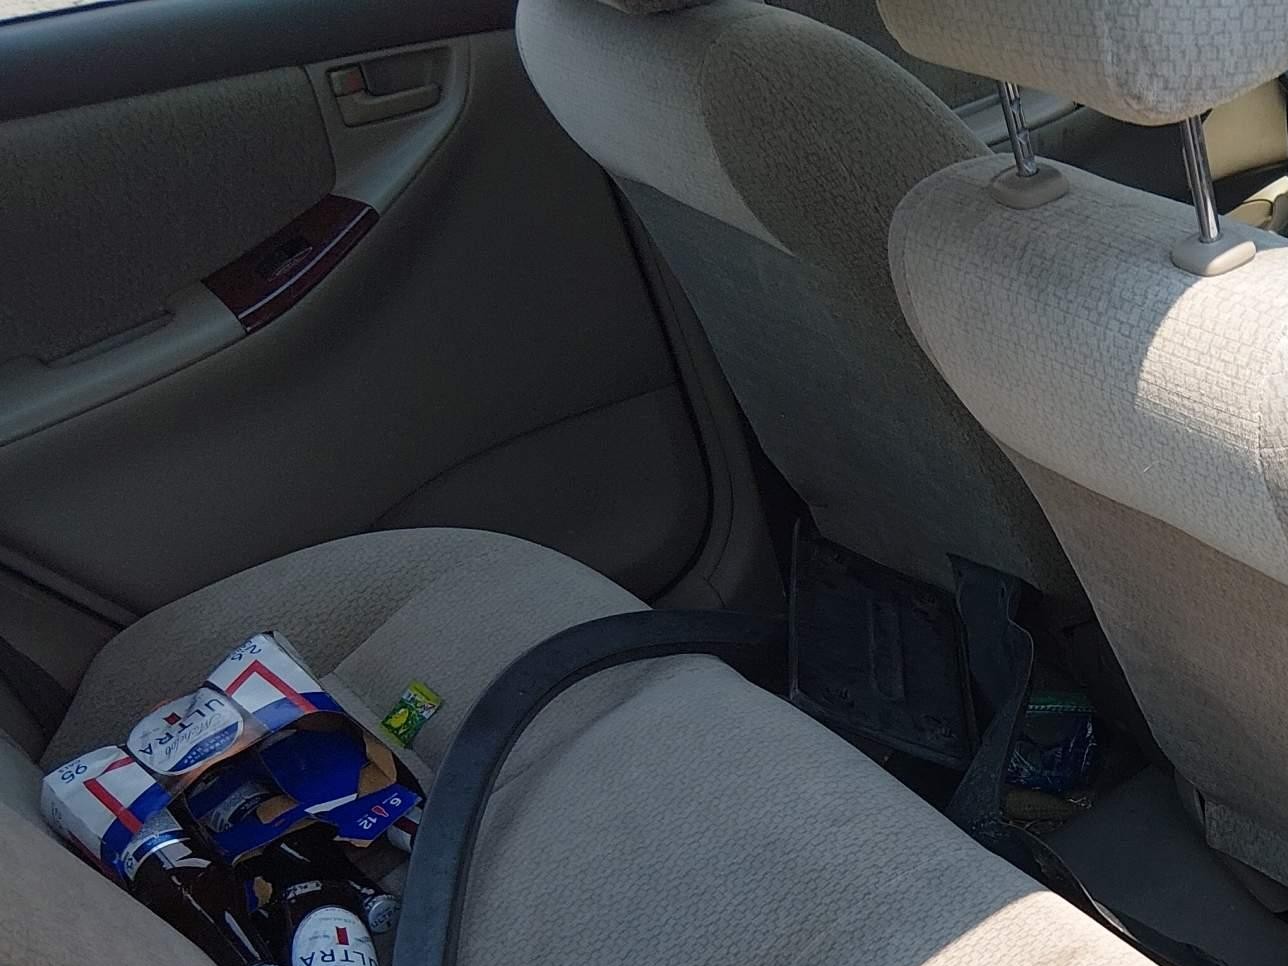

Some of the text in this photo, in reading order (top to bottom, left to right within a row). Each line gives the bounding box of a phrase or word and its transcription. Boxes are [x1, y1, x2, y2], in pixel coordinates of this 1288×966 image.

[139, 698, 225, 756] ULTRA
[60, 763, 88, 785] 95
[389, 797, 402, 807] 6
[358, 815, 378, 830] 12
